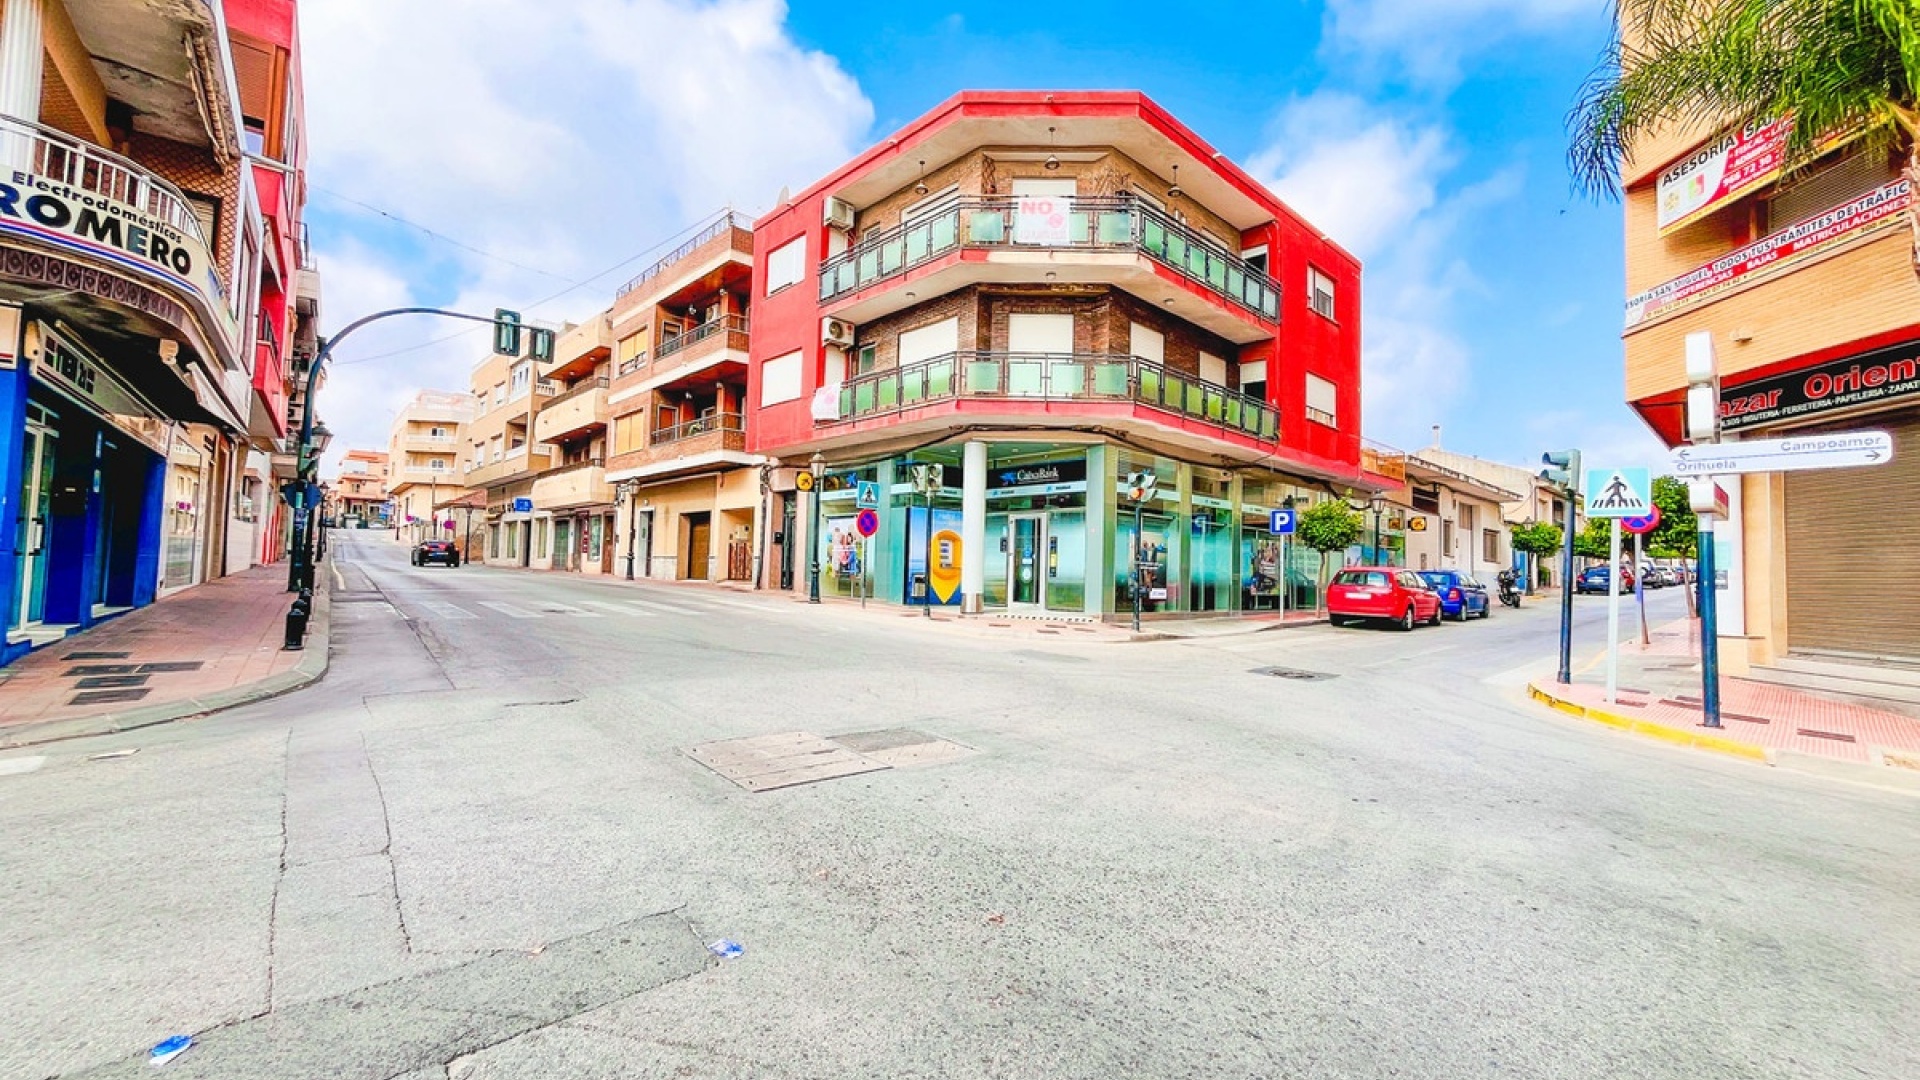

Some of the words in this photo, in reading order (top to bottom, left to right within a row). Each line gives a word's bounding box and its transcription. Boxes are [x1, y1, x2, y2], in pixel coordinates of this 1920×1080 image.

[1661, 134, 1735, 187] ASESORIA
[12, 170, 181, 244] Electrodomésticos
[1020, 201, 1054, 215] NO
[0, 182, 192, 275] ROMERO
[1713, 253, 1748, 272] TODOS
[1751, 243, 1771, 256] TUS
[1836, 204, 1854, 221] DE
[1719, 388, 1783, 418] azar
[1780, 436, 1882, 452] Campoamor
[1017, 466, 1060, 482] CaixaBank
[1676, 460, 1737, 472] Orihuela
[1274, 512, 1290, 531] P
